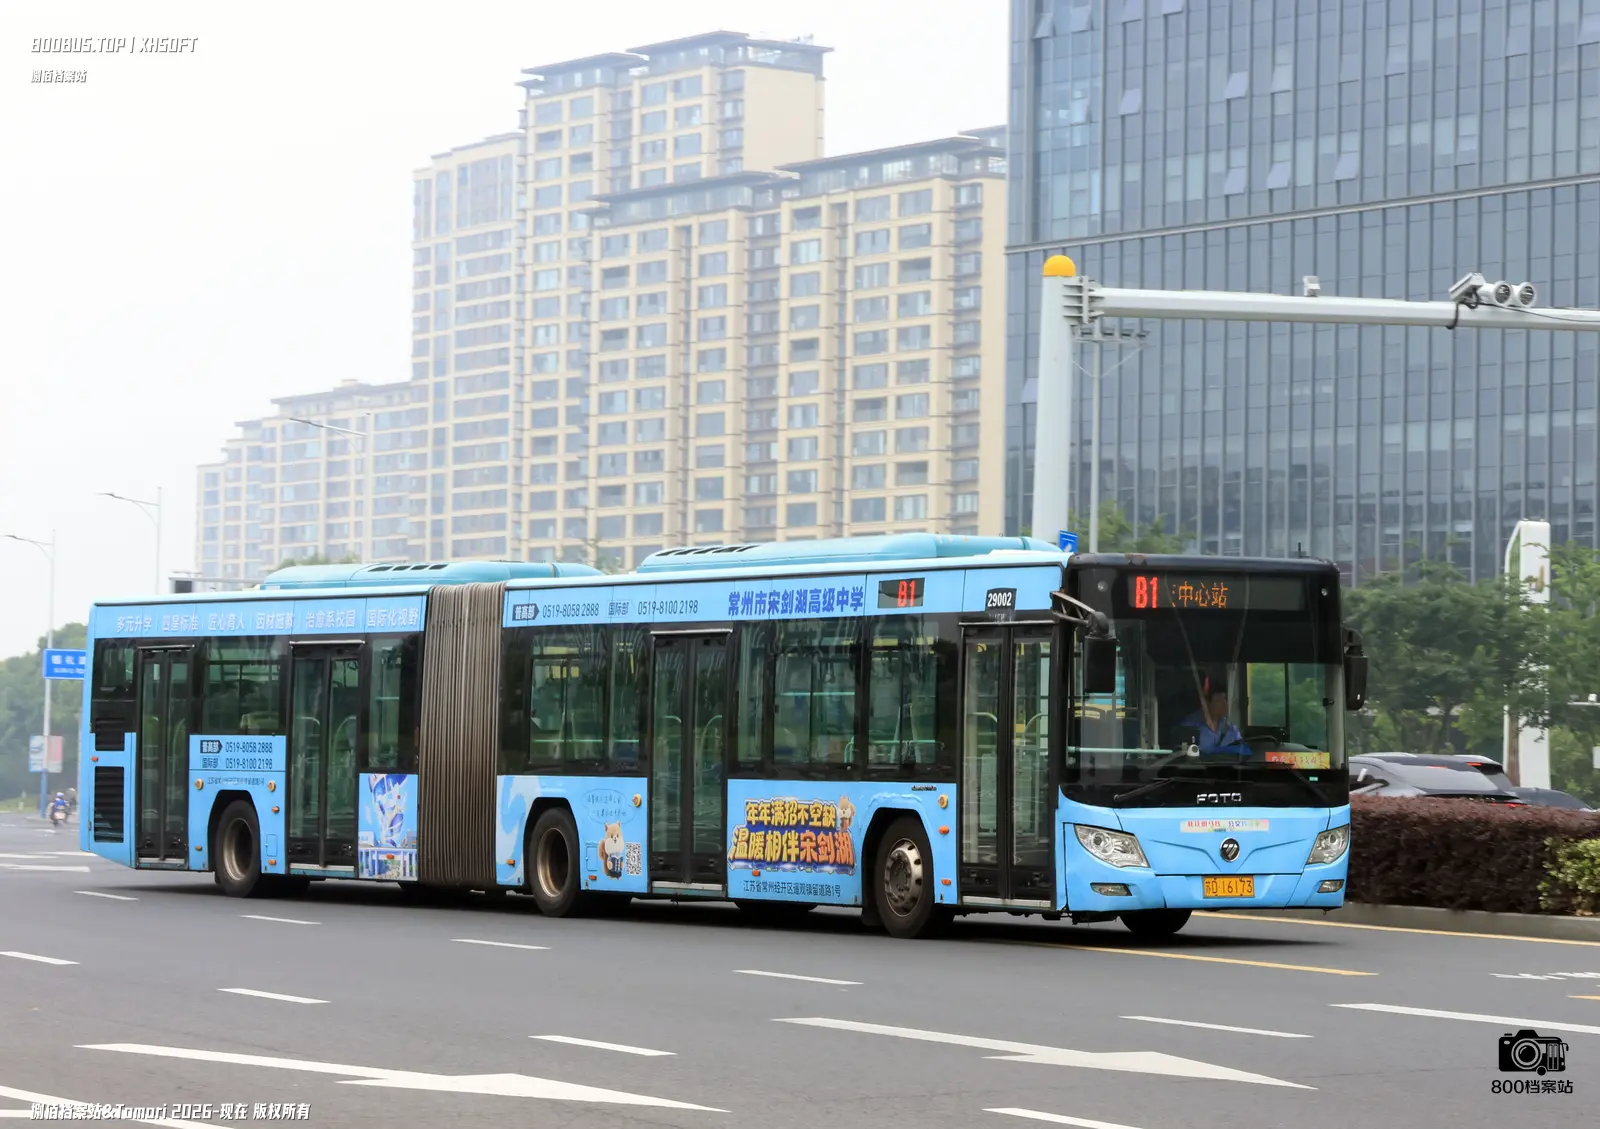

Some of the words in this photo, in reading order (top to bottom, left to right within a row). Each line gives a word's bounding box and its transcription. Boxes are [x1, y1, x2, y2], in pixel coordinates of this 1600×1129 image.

[728, 586, 864, 616] 常州市宋剑湖高级中学
[897, 580, 916, 607] B1
[987, 592, 1012, 607] 29002
[1135, 576, 1158, 609] B1
[116, 615, 152, 633] 多元升学
[367, 608, 419, 627] 国际化视野
[514, 604, 536, 620] 普高部
[542, 603, 580, 619] 0519-8058
[581, 603, 600, 617] 2888
[608, 602, 630, 616] 国际部
[638, 600, 678, 615] 0519-8100
[679, 599, 699, 614] 2198
[225, 742, 257, 753] 0519-8058
[257, 742, 273, 753] 2888
[225, 758, 257, 769] 0519-8100
[257, 758, 273, 769] 2198
[746, 800, 836, 828] 年年满招不空缺
[728, 827, 855, 866] 温暖相伴宋剑湖
